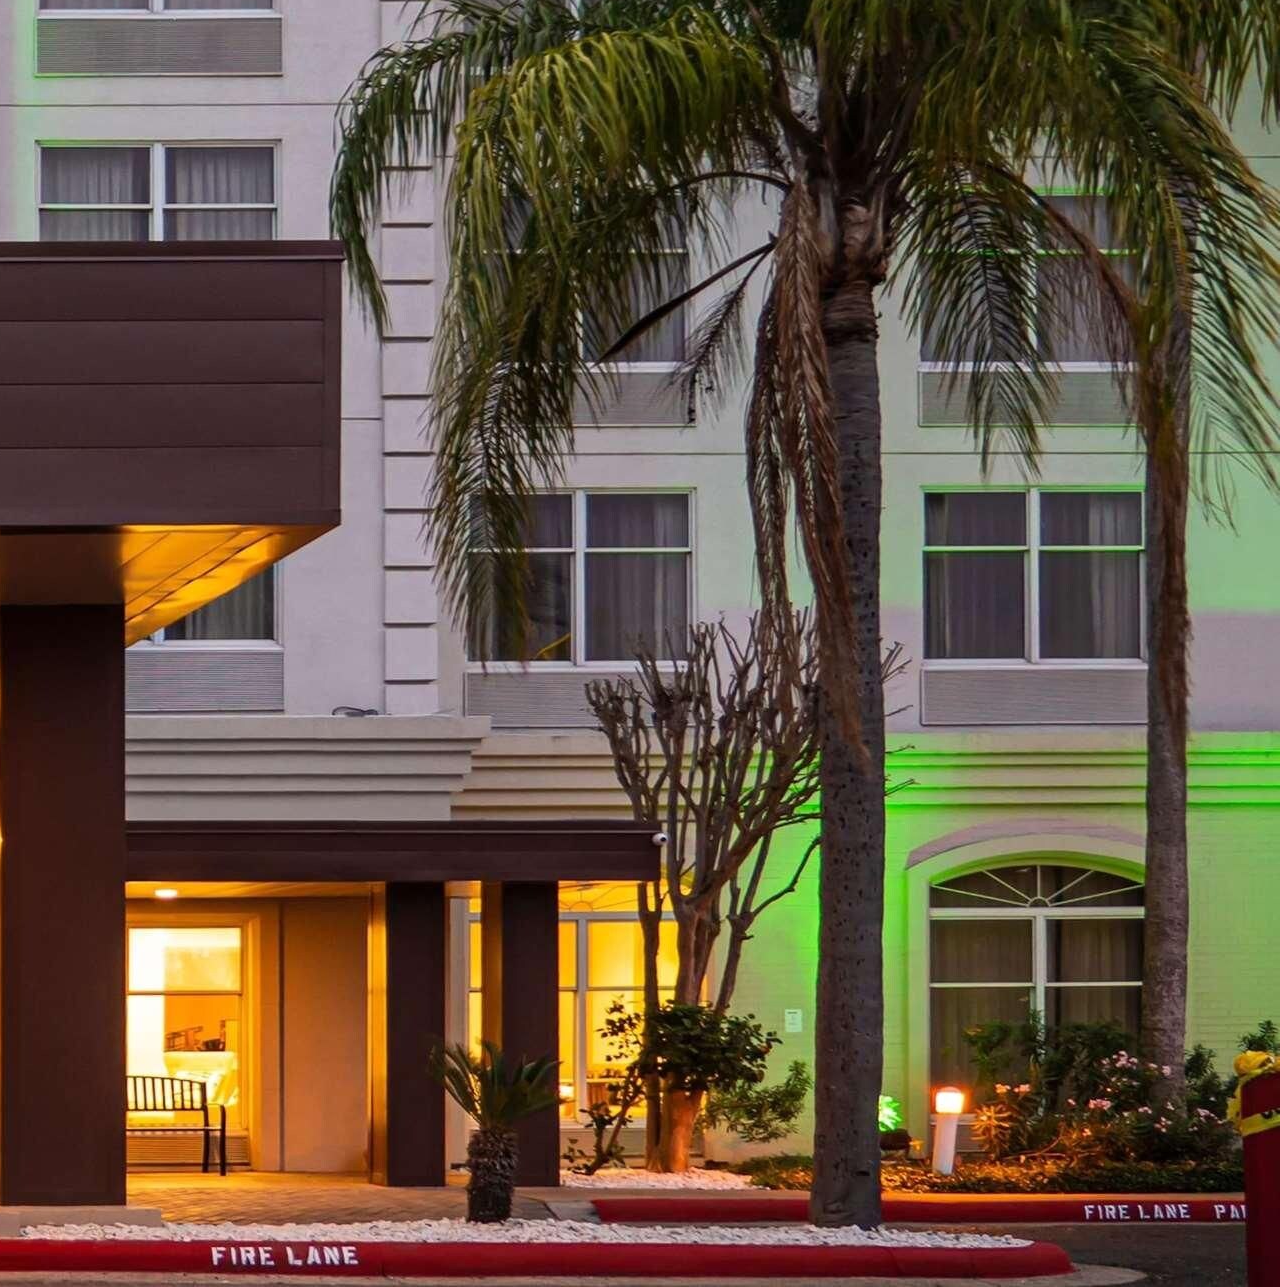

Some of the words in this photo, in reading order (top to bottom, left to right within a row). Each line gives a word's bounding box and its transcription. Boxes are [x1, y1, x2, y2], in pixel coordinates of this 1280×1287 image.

[1084, 1205, 1130, 1220] FIRE
[1138, 1204, 1191, 1219] LANE
[211, 1246, 275, 1266] FIRE
[286, 1246, 359, 1266] LANE
